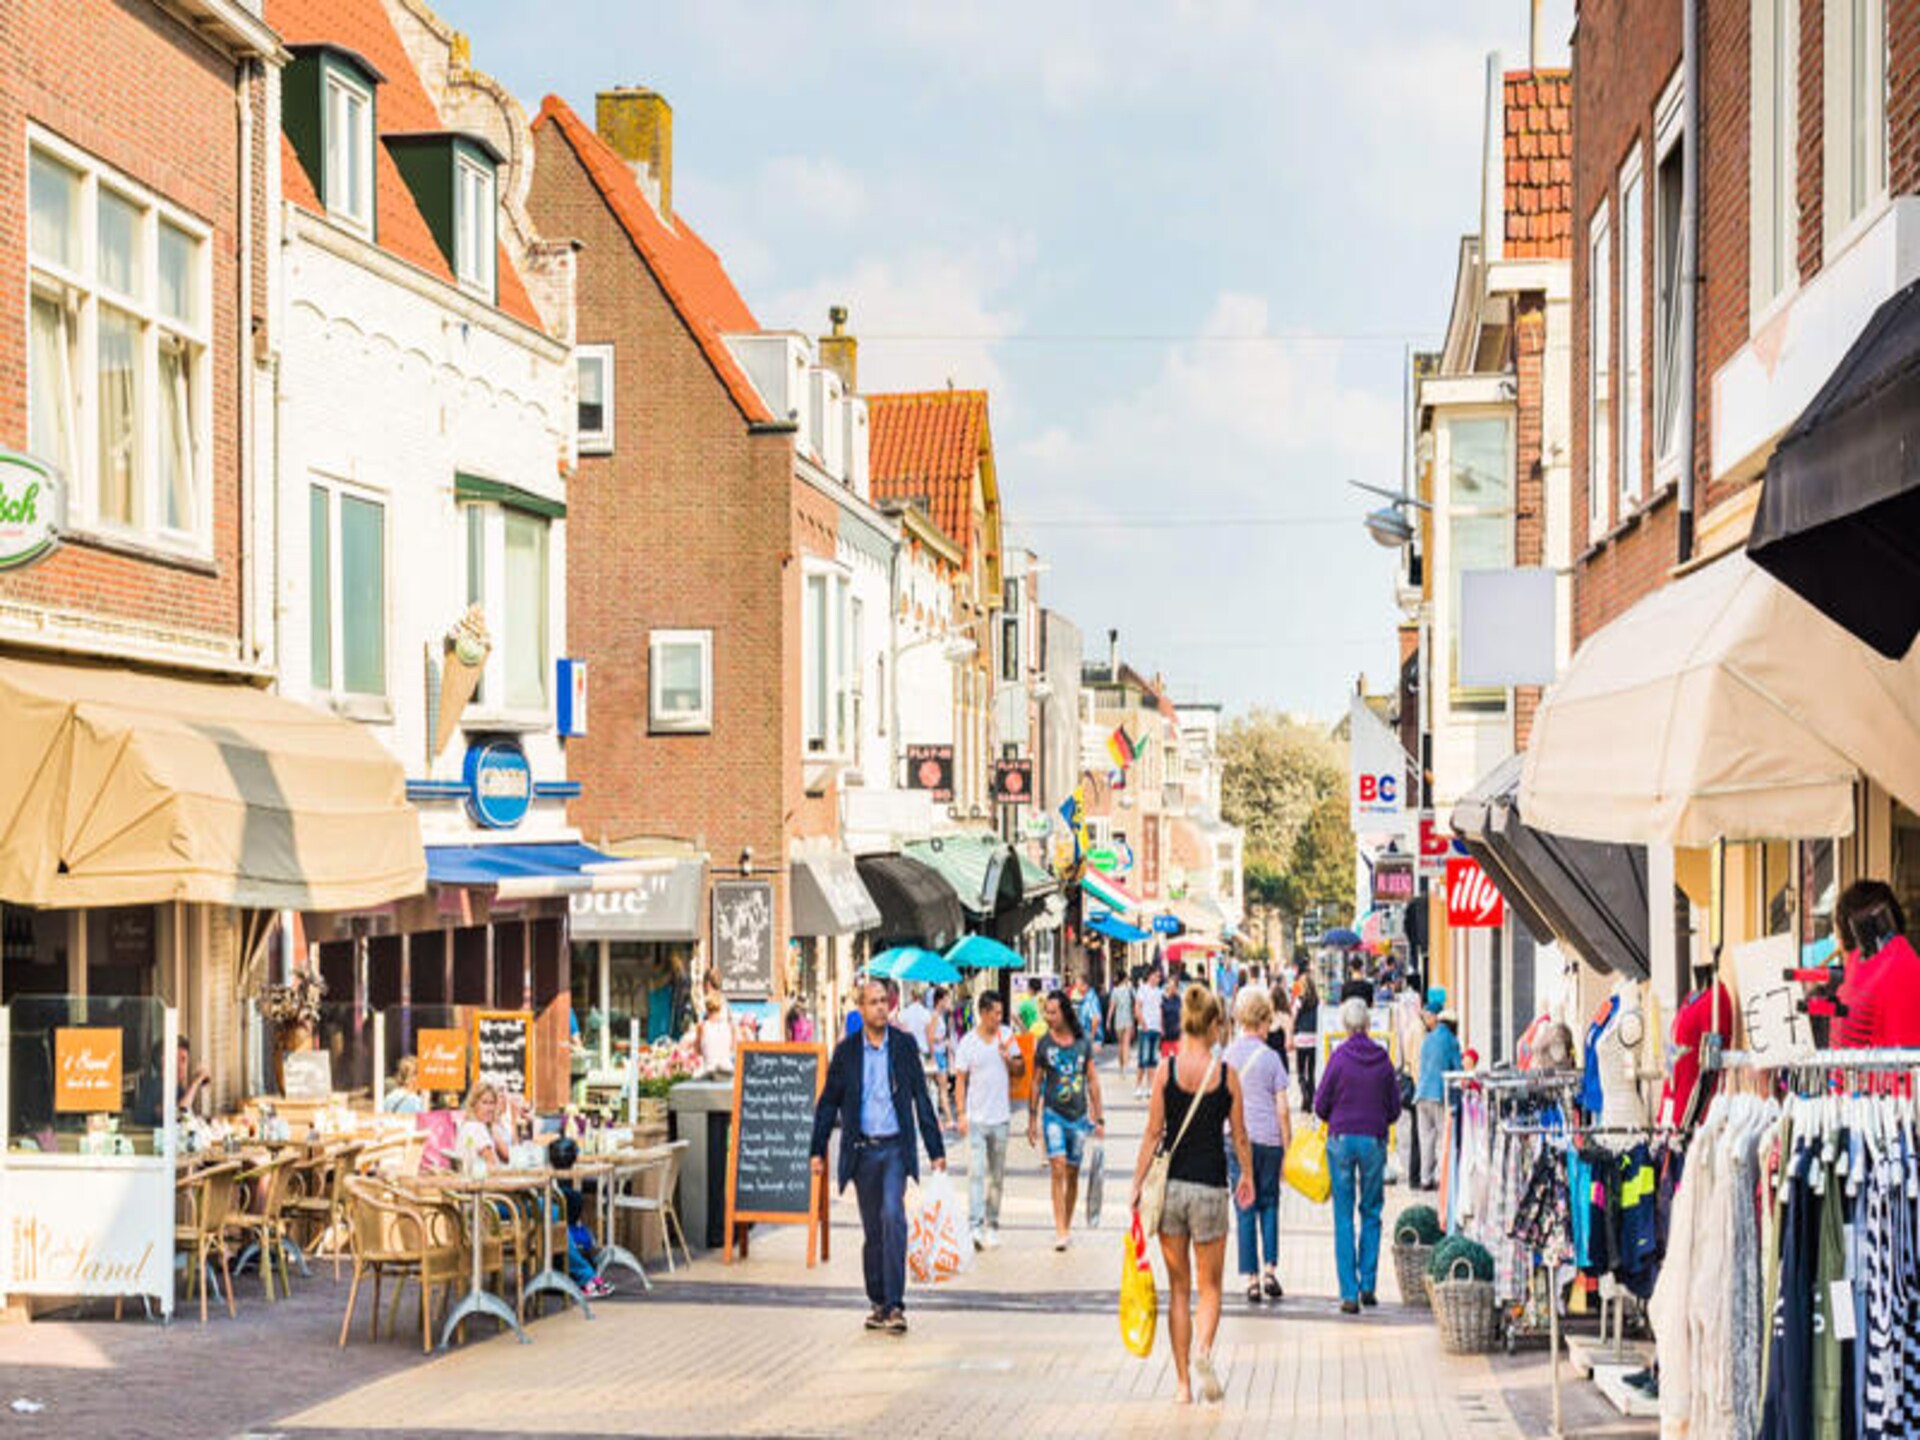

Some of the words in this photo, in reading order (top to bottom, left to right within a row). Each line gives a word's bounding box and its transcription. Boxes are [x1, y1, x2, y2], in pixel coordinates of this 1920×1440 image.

[0, 481, 40, 524] sch
[1359, 774, 1397, 802] BC
[1451, 866, 1500, 923] illy
